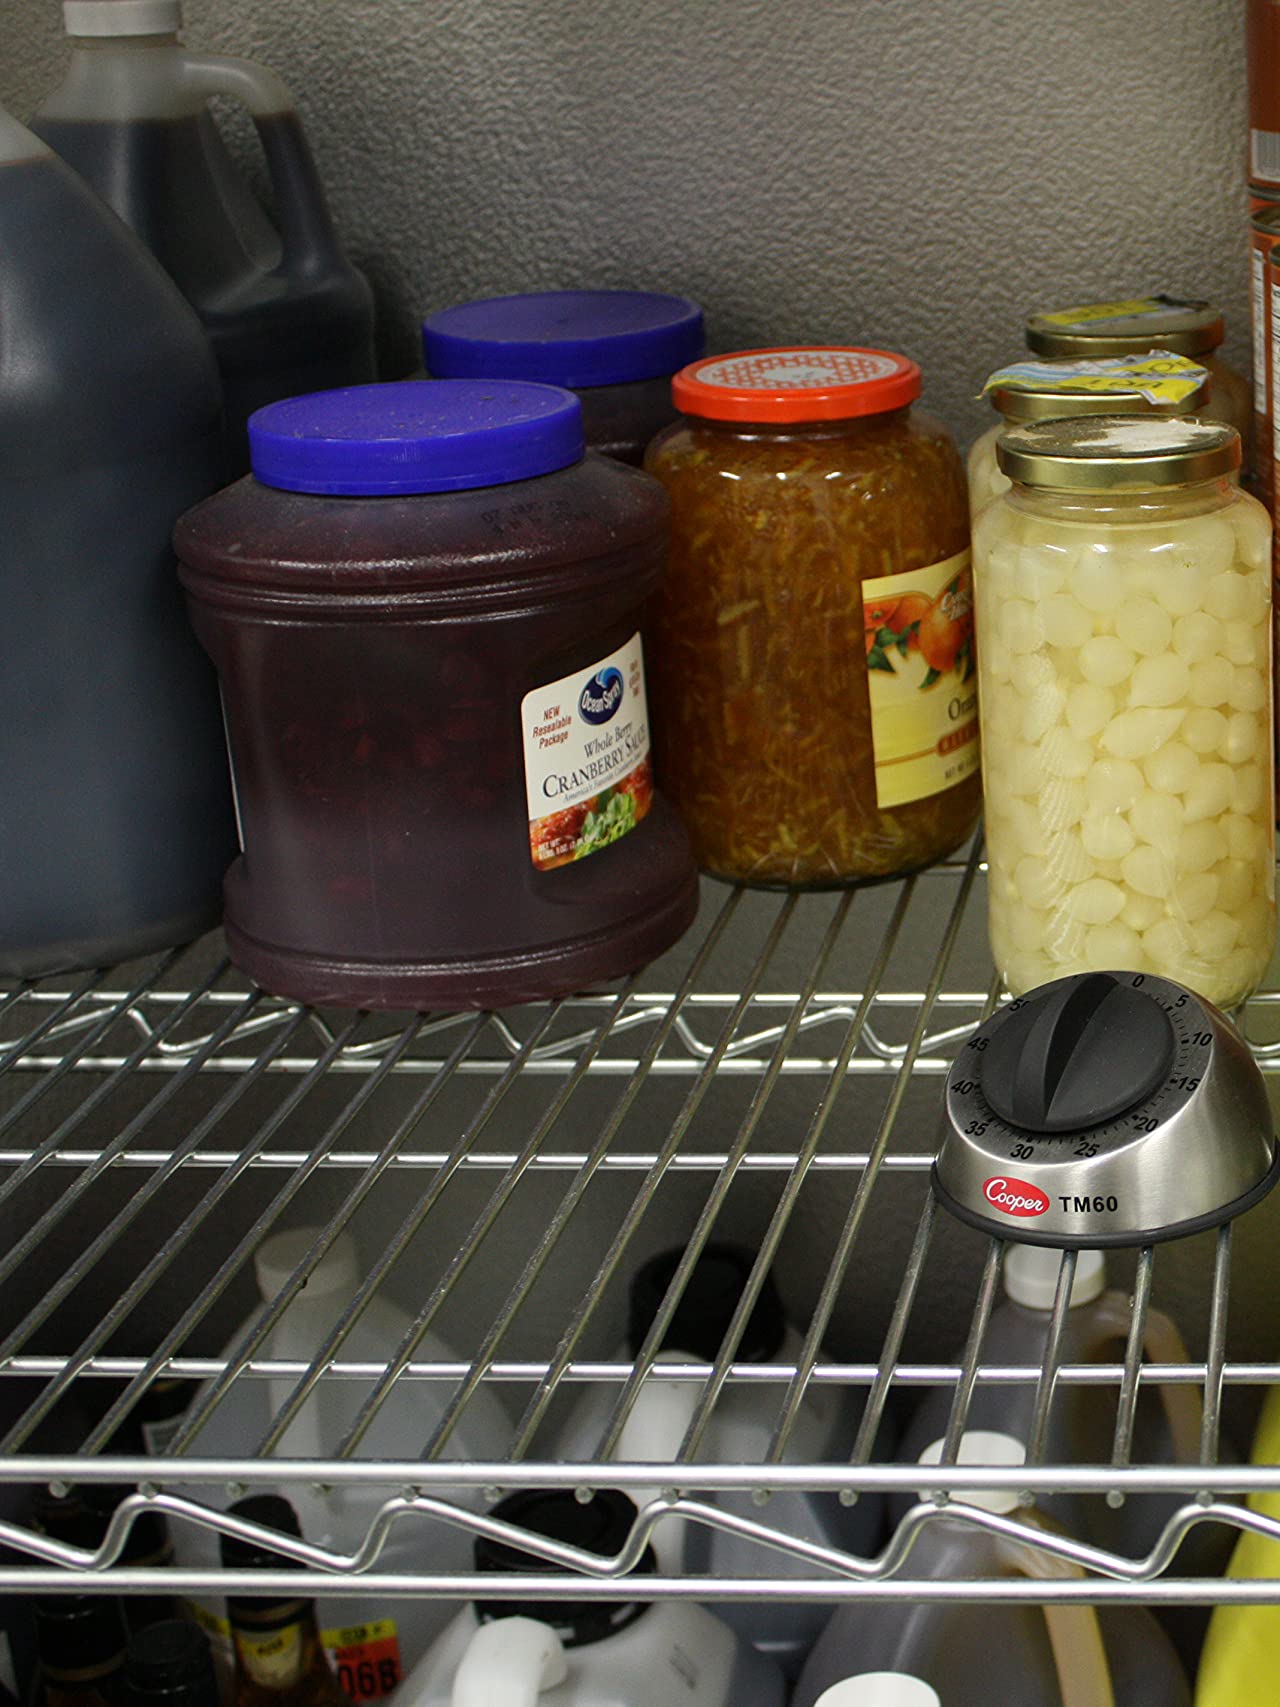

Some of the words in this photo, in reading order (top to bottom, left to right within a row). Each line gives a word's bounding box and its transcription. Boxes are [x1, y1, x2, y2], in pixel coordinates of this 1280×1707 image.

[543, 705, 560, 720] NEW
[532, 715, 572, 738] Resealable
[539, 731, 569, 749] Package
[584, 732, 612, 758] Whole
[613, 720, 632, 743] Berry
[542, 747, 624, 798] CRANBERRY
[1132, 975, 1145, 987] 0
[1176, 994, 1189, 1008] 5
[967, 1037, 990, 1052] 45
[1191, 1032, 1214, 1047] 10
[951, 1081, 974, 1095] 40
[1177, 1076, 1201, 1092] 15
[964, 1121, 989, 1137] 35
[1134, 1118, 1159, 1133] 20
[1010, 1144, 1034, 1160] 30
[1073, 1142, 1100, 1158] 25
[986, 1179, 1044, 1211] Cooper
[1059, 1196, 1118, 1213] TM60
